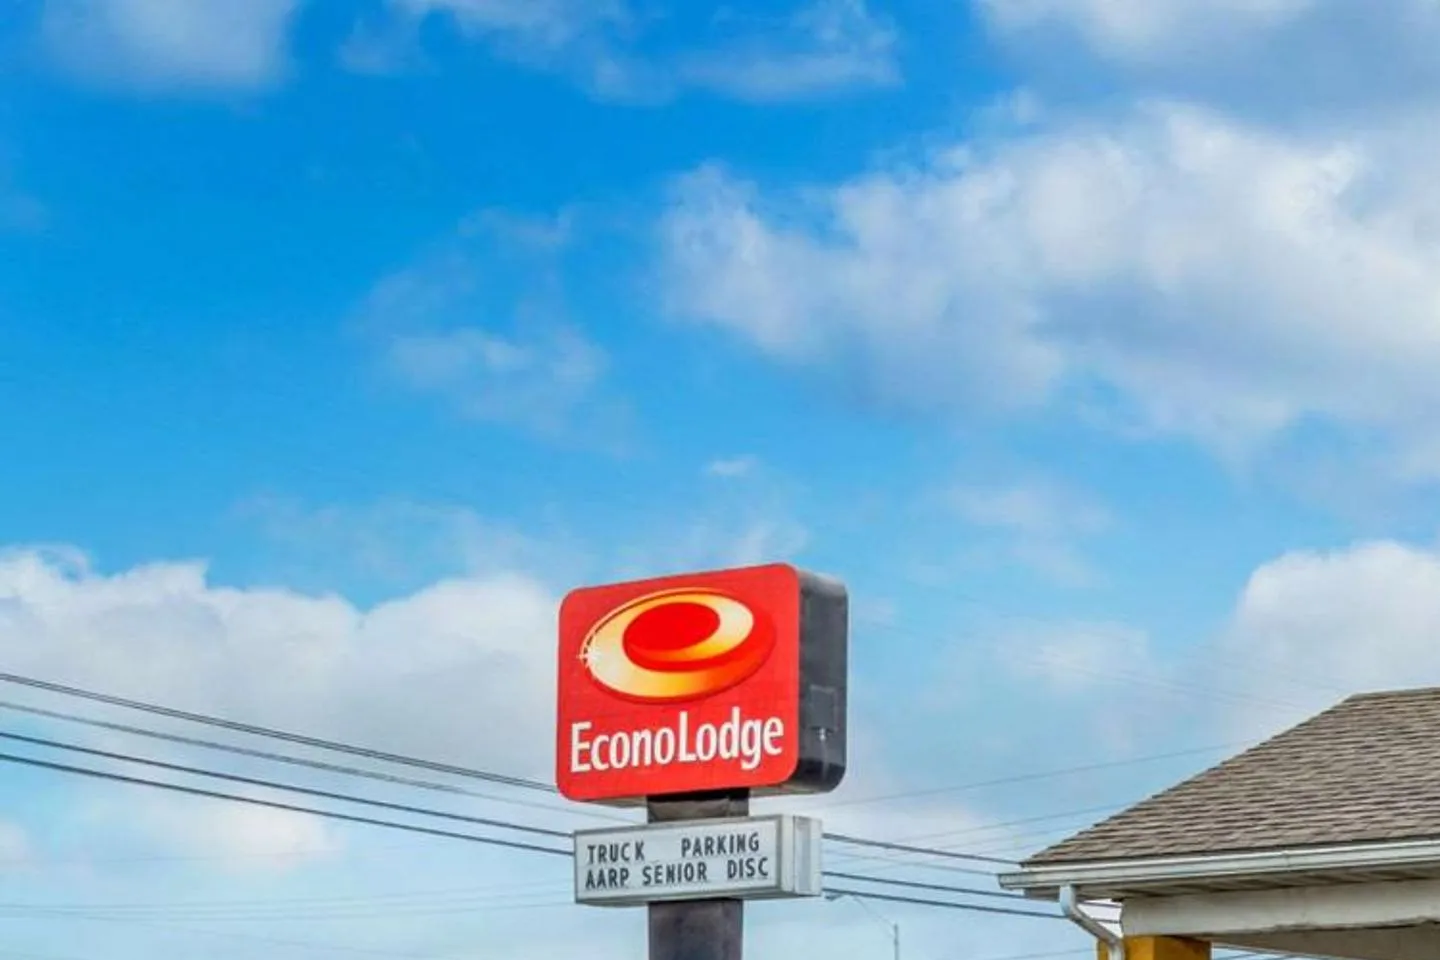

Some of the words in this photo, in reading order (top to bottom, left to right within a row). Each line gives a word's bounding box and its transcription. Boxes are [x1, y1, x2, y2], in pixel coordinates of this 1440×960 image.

[570, 706, 784, 772] EconoLodge
[587, 841, 645, 864] TRUCK
[681, 832, 760, 858] PARKING
[585, 868, 629, 890] AARP
[642, 862, 708, 886] SENIOR
[727, 857, 769, 879] DISC
